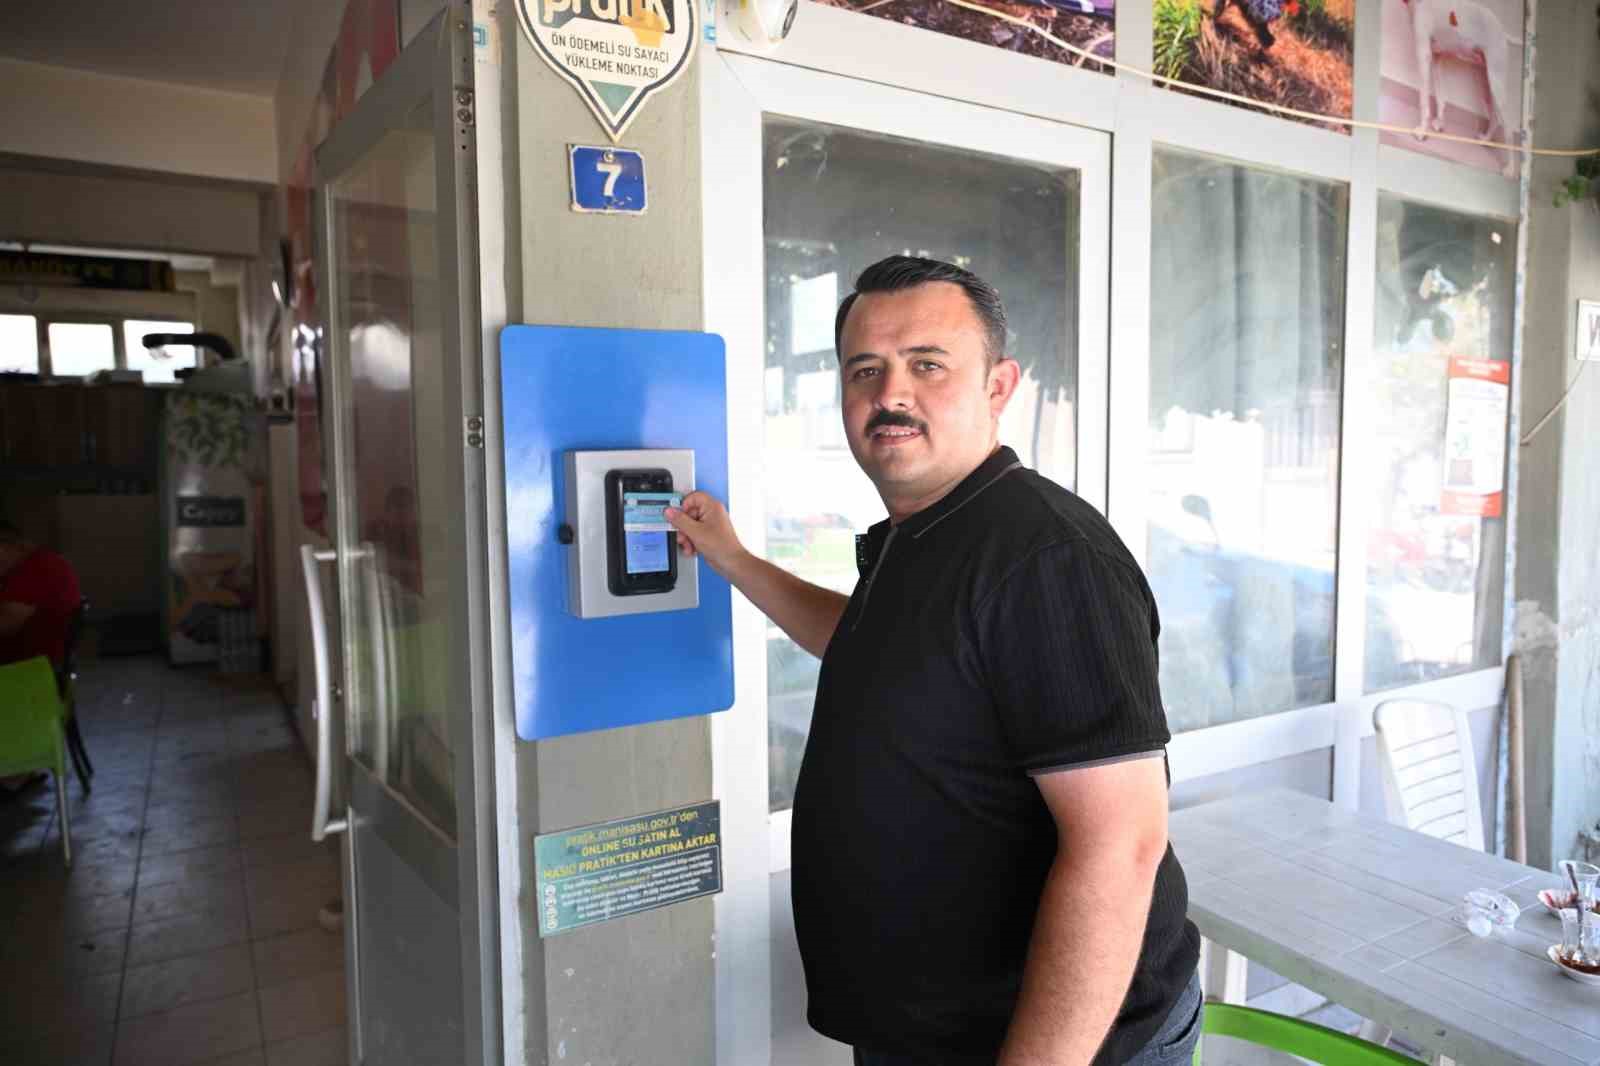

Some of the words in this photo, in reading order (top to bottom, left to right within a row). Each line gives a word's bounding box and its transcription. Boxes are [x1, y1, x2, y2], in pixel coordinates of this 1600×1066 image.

[552, 33, 566, 47] ÖN
[569, 36, 615, 55] ÖDEMELİ
[617, 44, 631, 58] SU
[634, 47, 670, 64] SAYACI
[564, 53, 613, 73] YÜKLEME
[616, 62, 659, 79] NOKTASI
[597, 161, 622, 197] 7
[622, 836, 637, 848] SU
[639, 829, 667, 844] SATIN
[669, 827, 682, 839] AL
[640, 840, 684, 859] KARTINA
[686, 832, 717, 850] AKTAR
